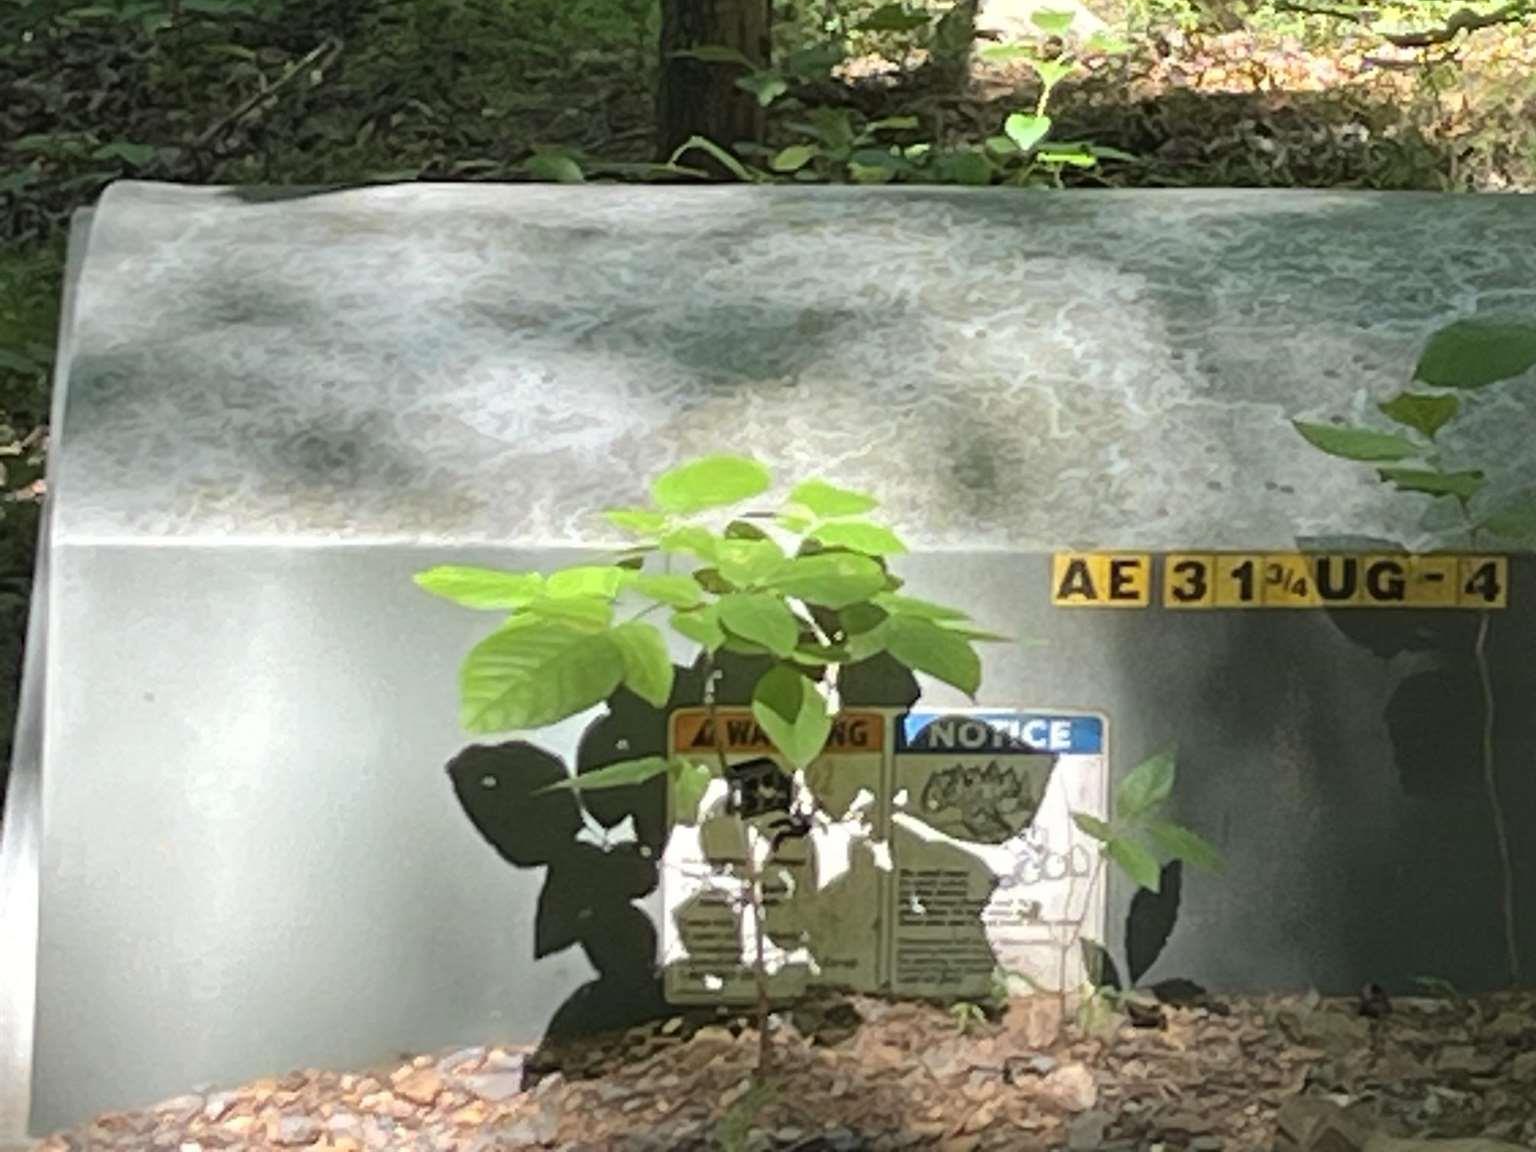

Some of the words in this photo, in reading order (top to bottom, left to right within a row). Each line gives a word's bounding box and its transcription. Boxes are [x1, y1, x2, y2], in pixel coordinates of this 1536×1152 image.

[1057, 559, 1140, 600] AE
[726, 719, 868, 747] WANG
[929, 719, 1071, 748] NOTICE
